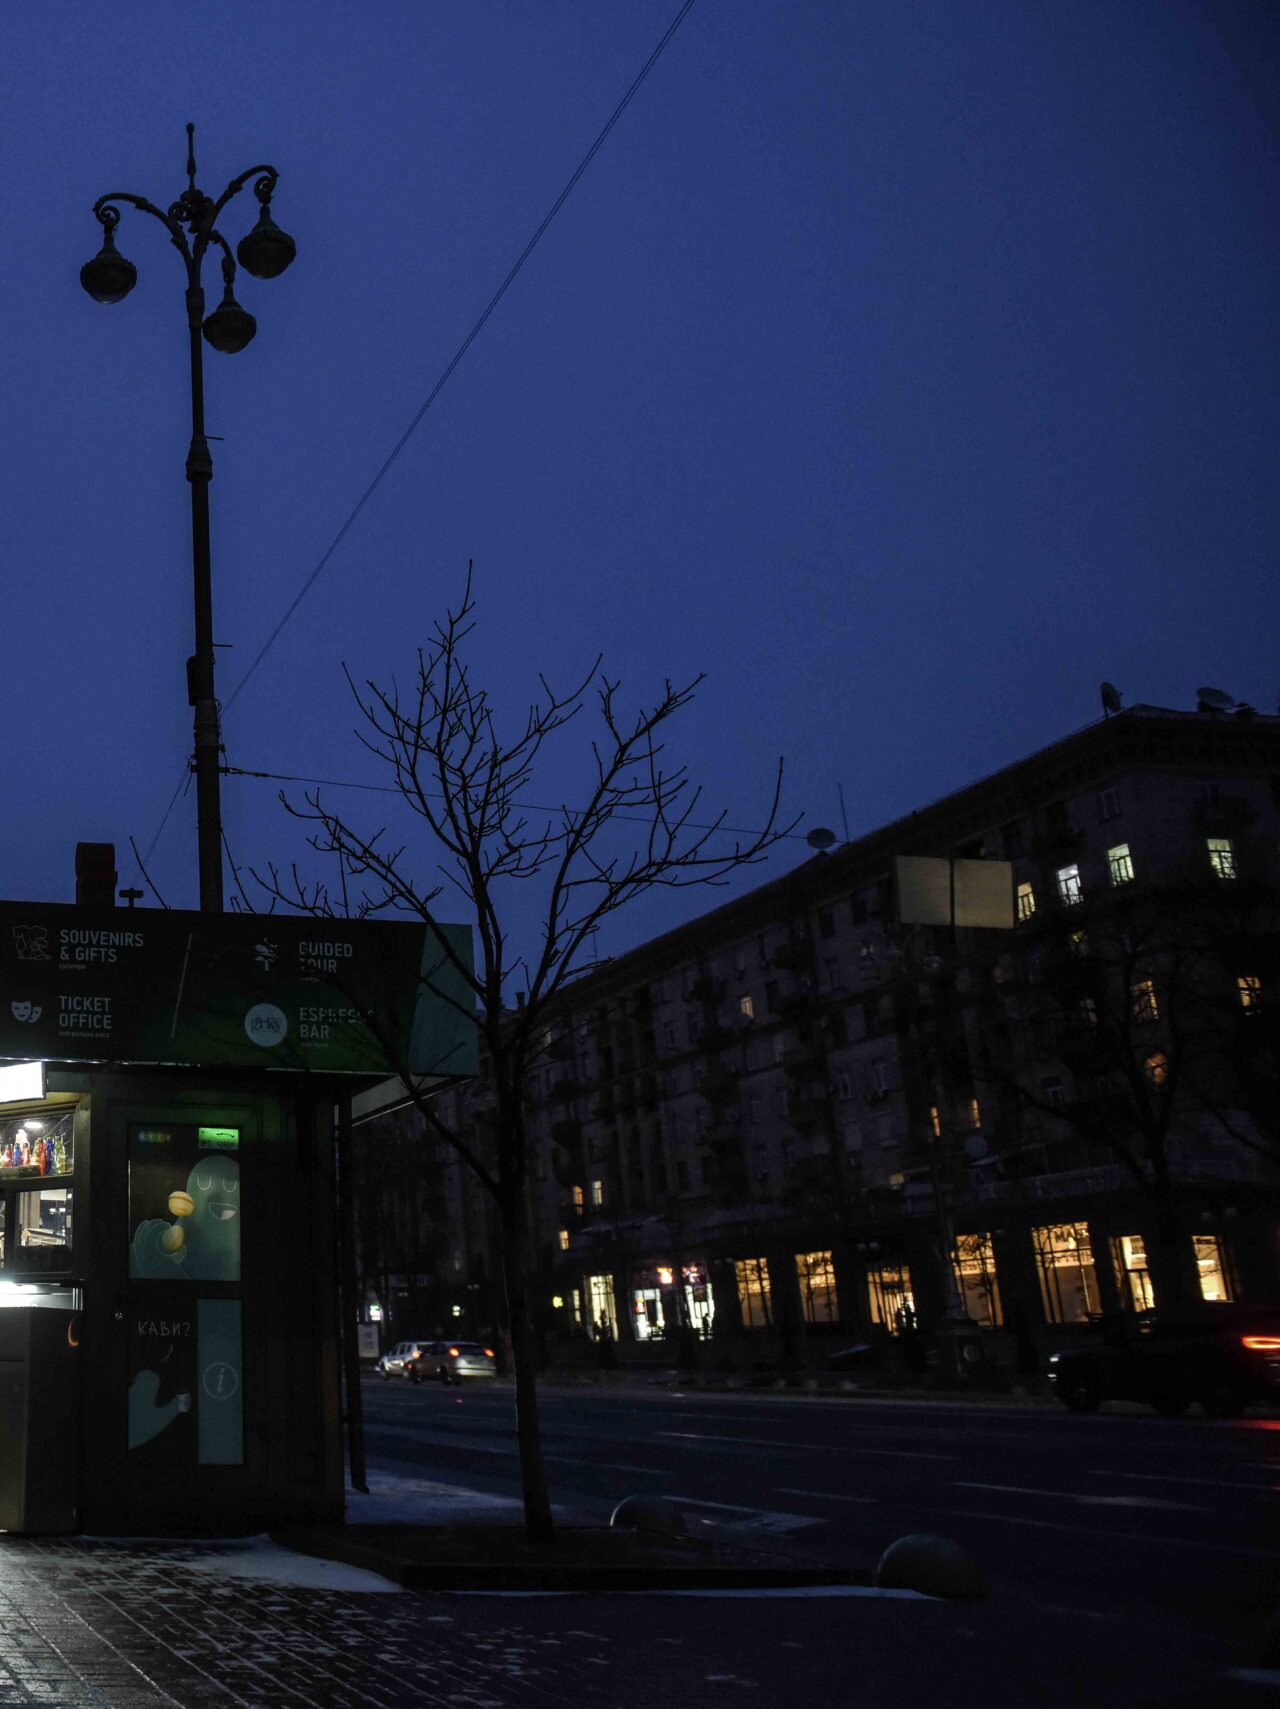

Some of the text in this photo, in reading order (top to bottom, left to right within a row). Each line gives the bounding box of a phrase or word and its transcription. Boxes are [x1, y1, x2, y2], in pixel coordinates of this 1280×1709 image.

[59, 929, 144, 947] SOUVENIRS
[59, 946, 118, 963] & GIFTS
[298, 941, 353, 958] GUIDED
[58, 995, 112, 1012] TICKET
[58, 1012, 112, 1030] OFFICE
[299, 1024, 331, 1039] BAR
[137, 1320, 191, 1337] КАВИ?
